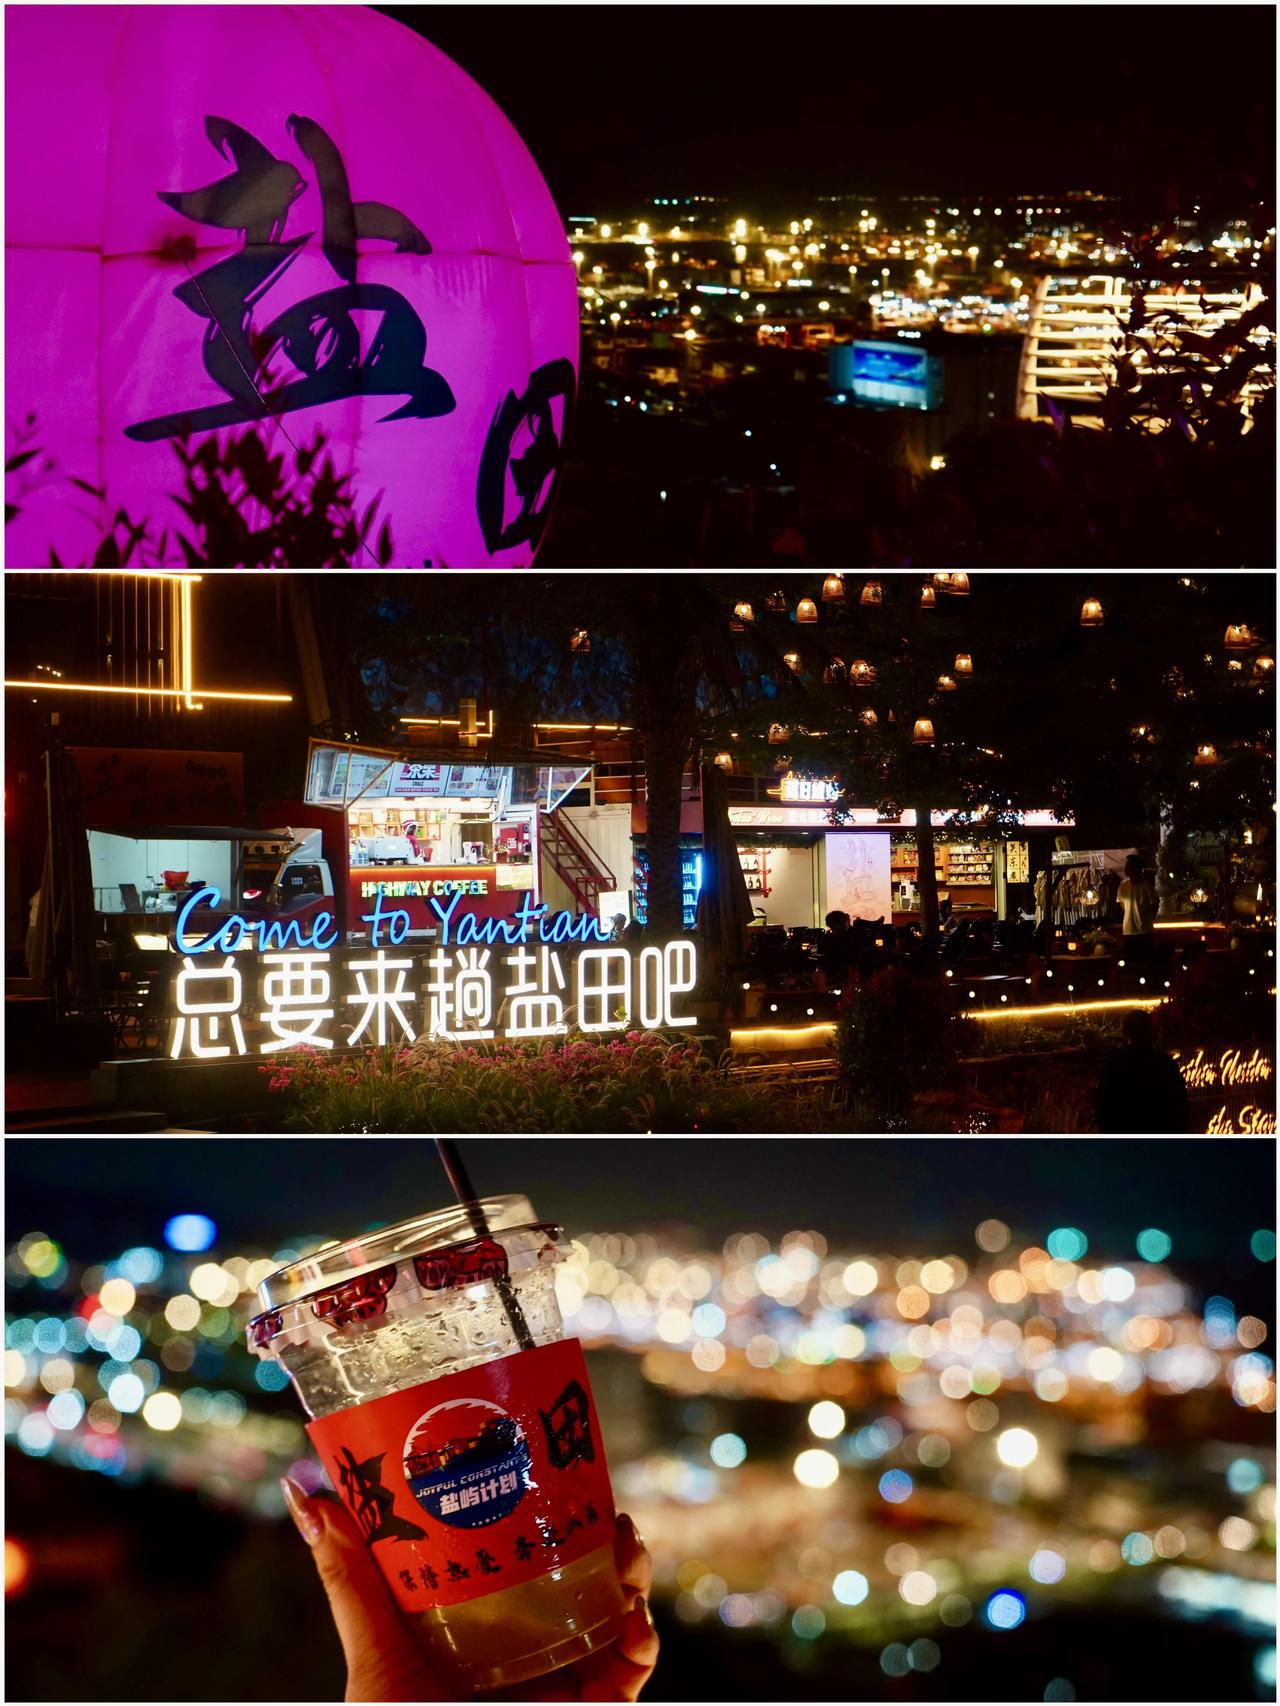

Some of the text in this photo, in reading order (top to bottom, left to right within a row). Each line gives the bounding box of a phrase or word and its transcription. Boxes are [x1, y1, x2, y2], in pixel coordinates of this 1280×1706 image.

[123, 114, 457, 443] 盐
[476, 357, 578, 558] 田
[176, 886, 612, 954] Come to Yantian
[361, 880, 488, 897] HIGHWAY COFFEE
[171, 940, 698, 1059] 总要来趟盐田吧
[416, 1480, 458, 1498] JOYFUL
[439, 1470, 518, 1516] 盐屿计划
